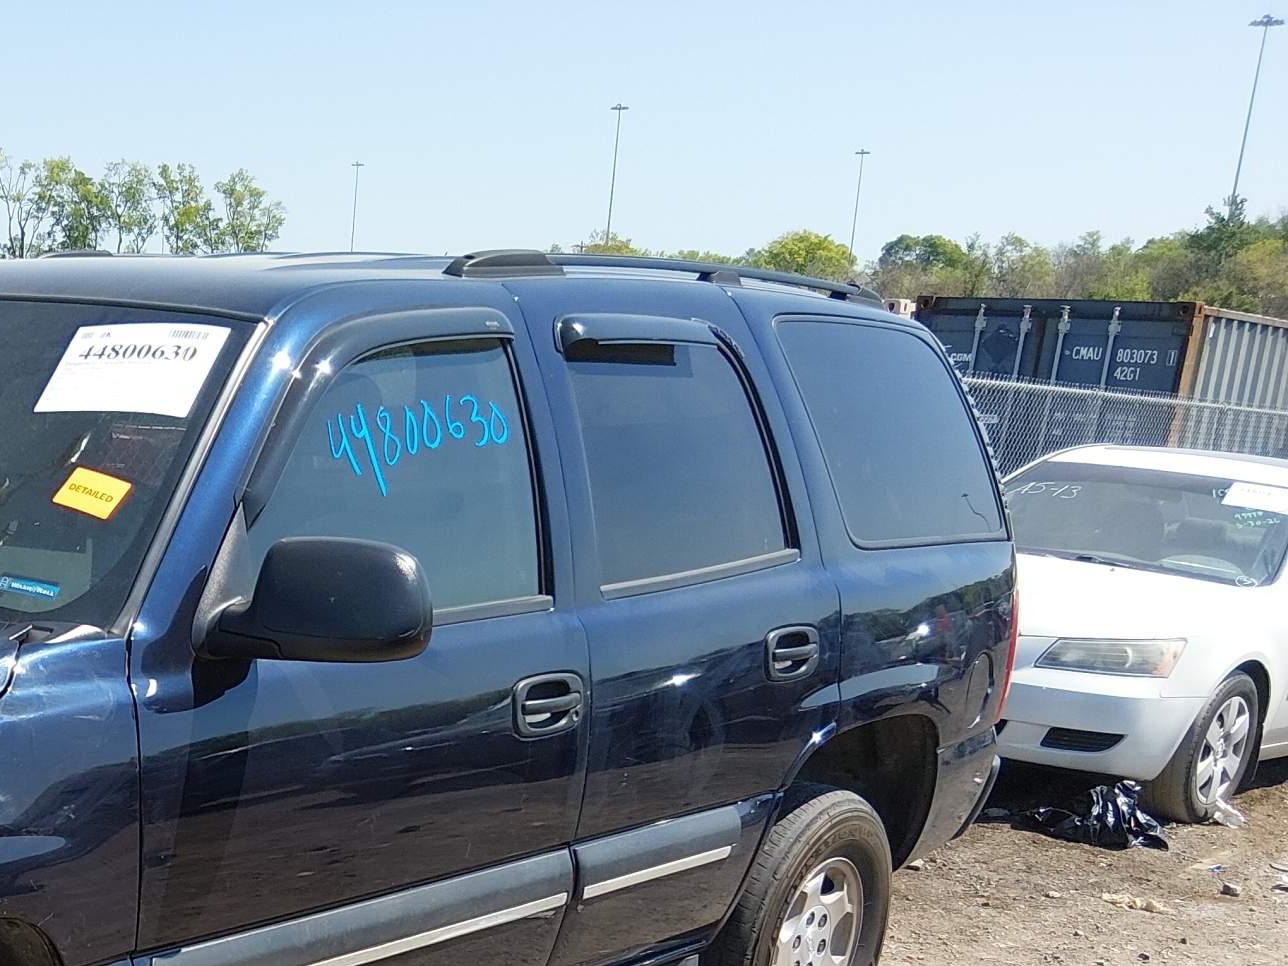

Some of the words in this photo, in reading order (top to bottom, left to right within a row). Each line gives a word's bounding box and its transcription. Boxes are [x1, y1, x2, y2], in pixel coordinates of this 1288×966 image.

[78, 343, 198, 361] 44800630
[1072, 346, 1103, 361] CMAU
[1115, 348, 1159, 365] 803073
[327, 394, 509, 497] 44800630
[68, 483, 114, 503] DETAILED
